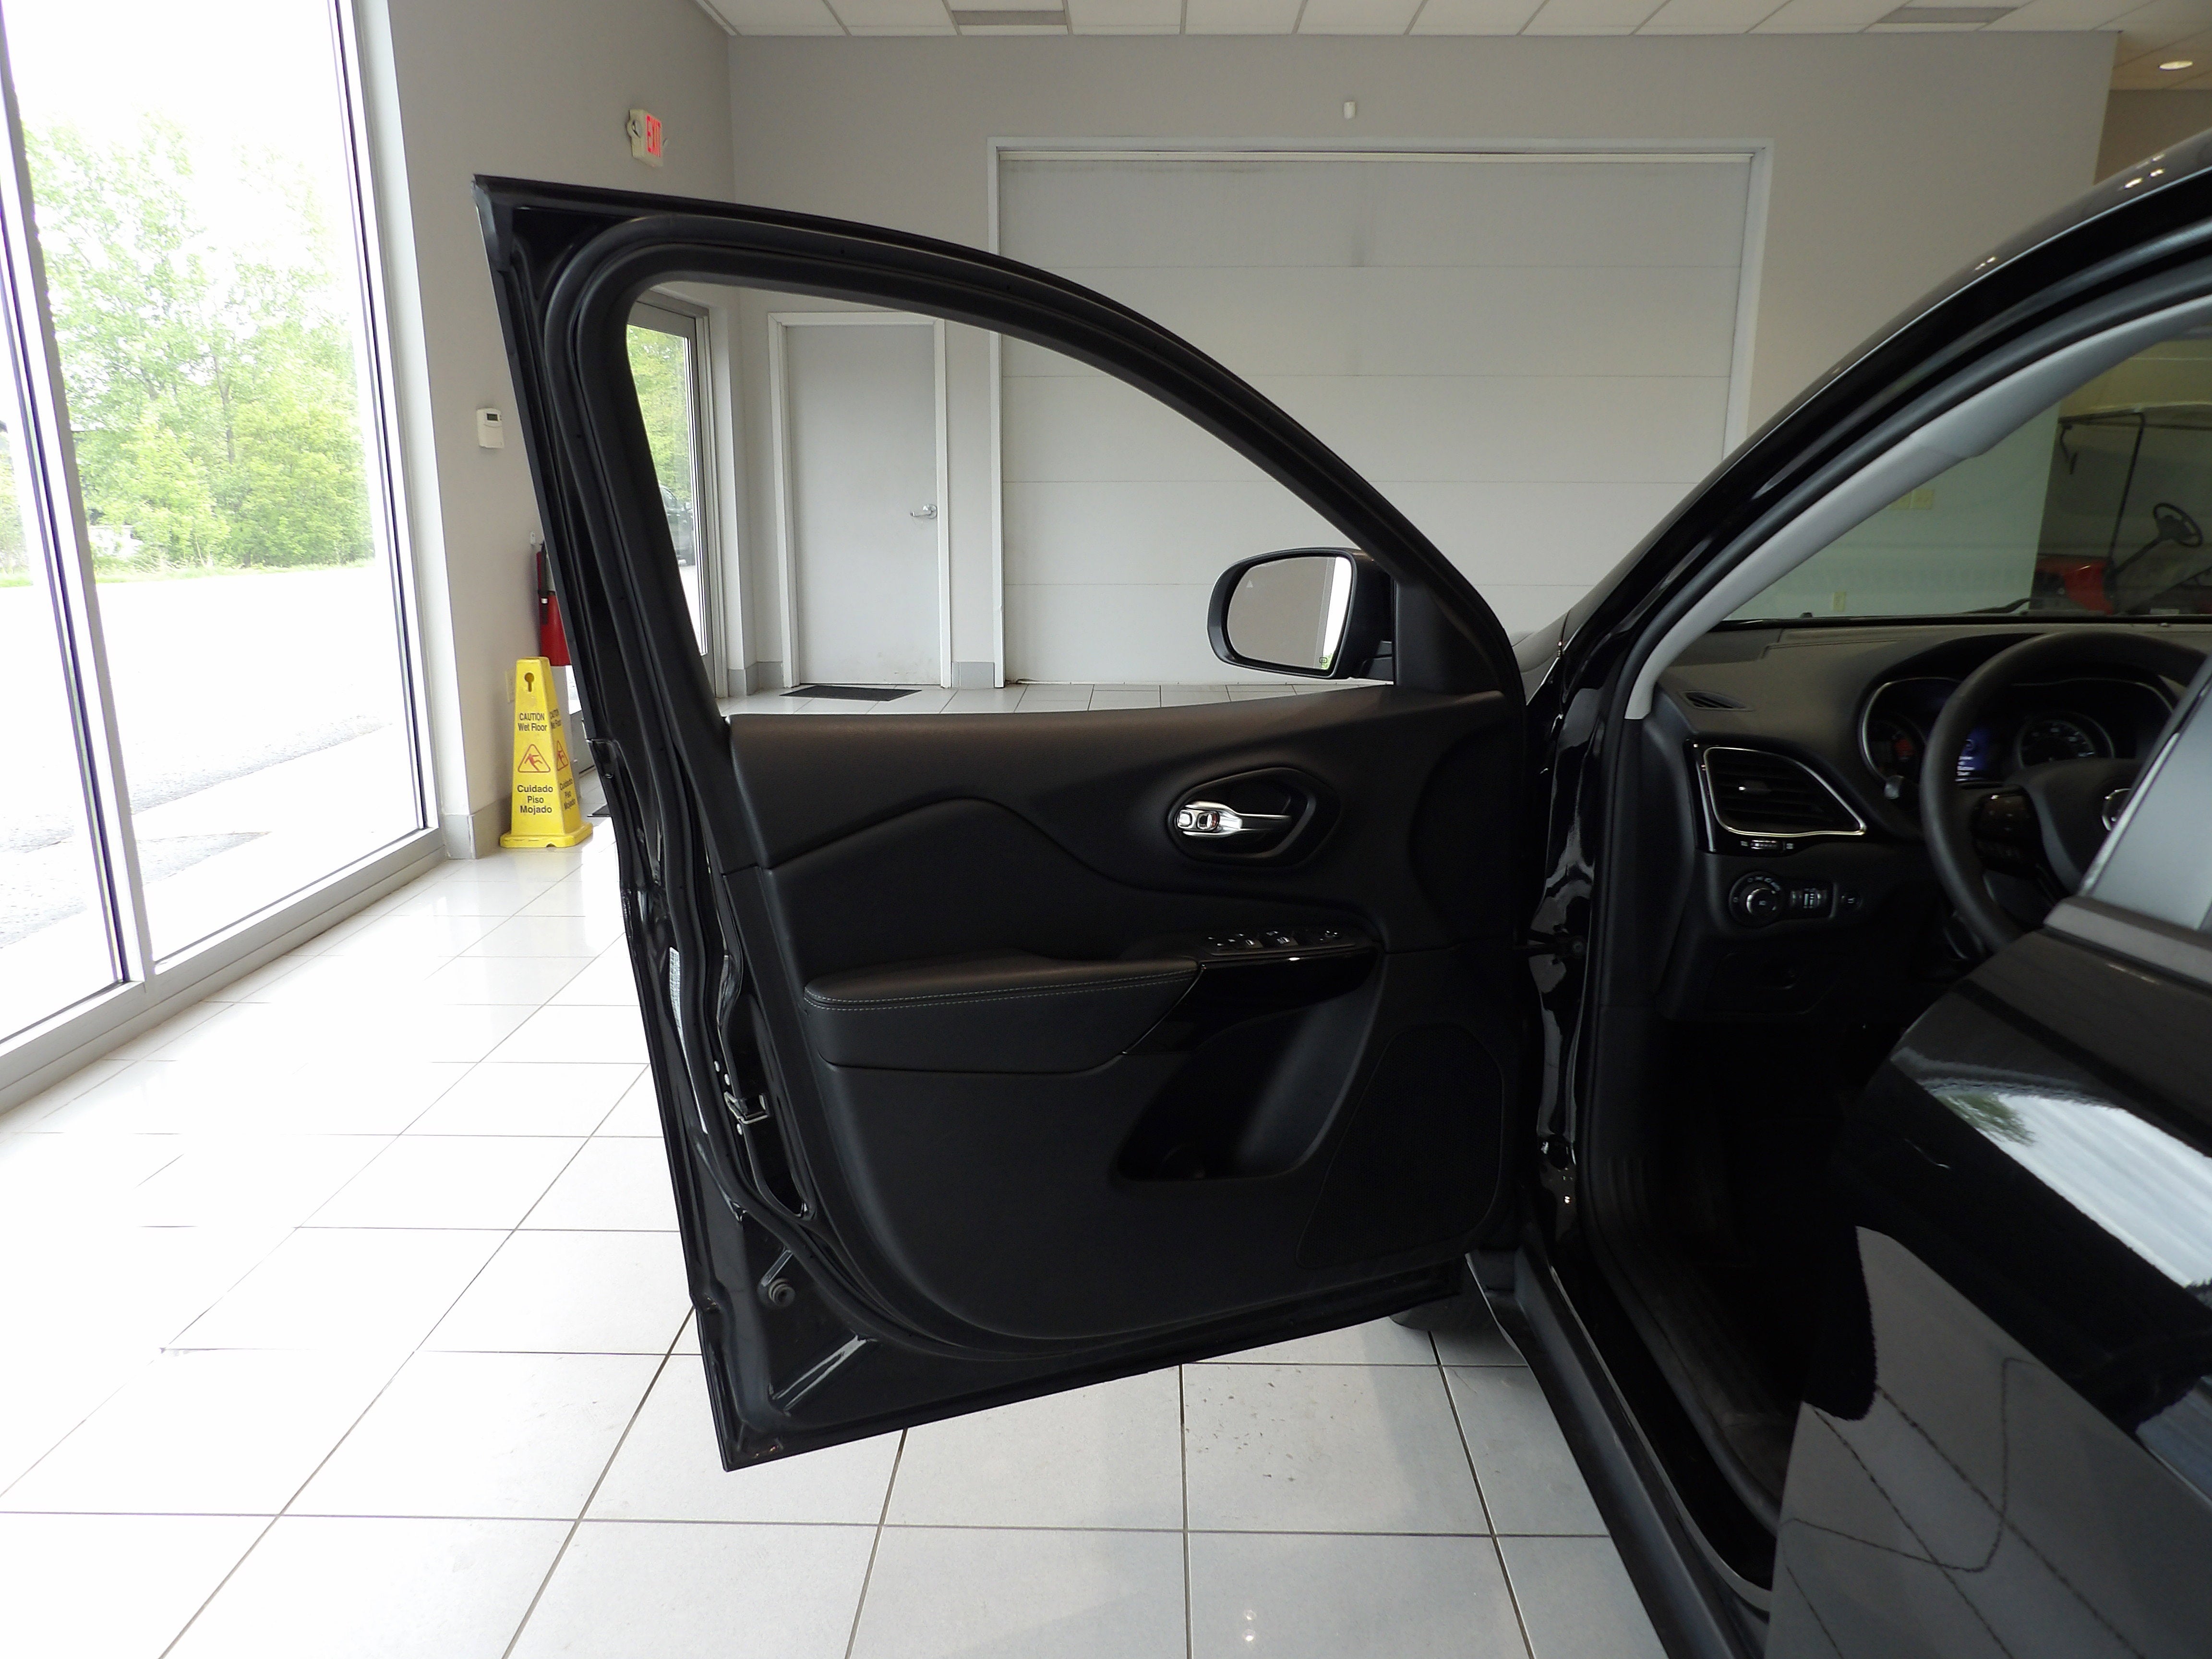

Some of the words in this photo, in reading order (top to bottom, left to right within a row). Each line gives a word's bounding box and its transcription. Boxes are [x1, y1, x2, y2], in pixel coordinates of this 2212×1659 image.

[519, 712, 545, 721] CAUTION
[517, 722, 530, 731] Wet
[531, 722, 547, 731] Floor
[517, 784, 553, 793] Cuidado
[520, 805, 553, 815] Mojado
